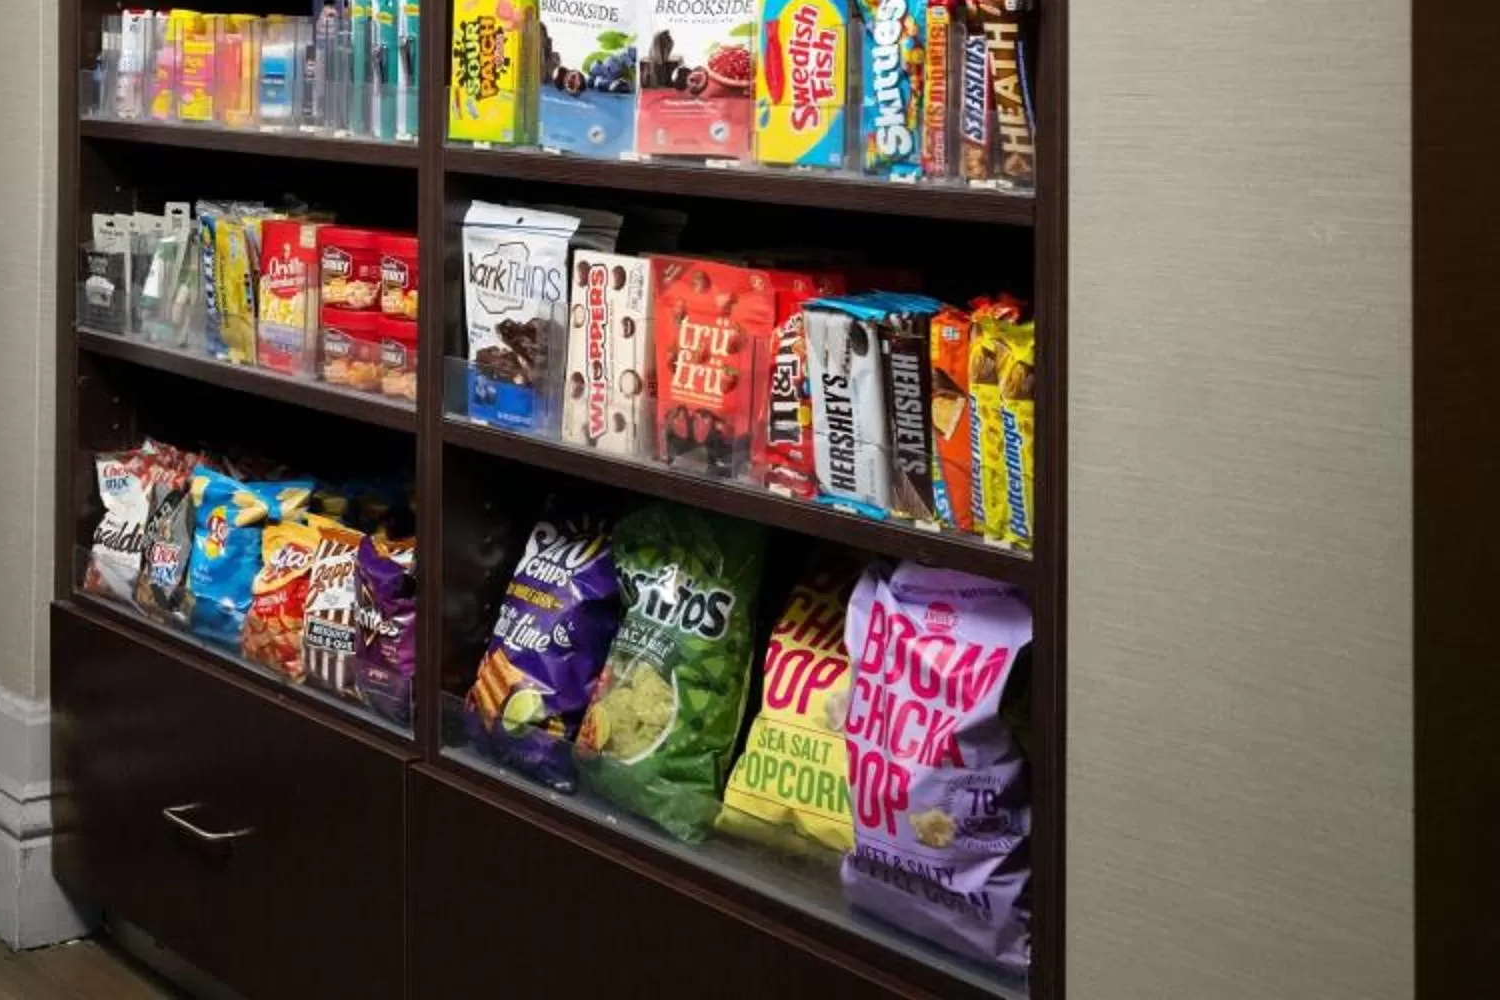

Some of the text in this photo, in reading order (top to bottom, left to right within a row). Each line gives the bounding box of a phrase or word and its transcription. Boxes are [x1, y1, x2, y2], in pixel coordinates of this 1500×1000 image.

[655, 0, 753, 16] BROOKSIDE
[466, 22, 480, 97] SOUR
[791, 4, 819, 131] Swedish
[812, 29, 837, 101] Fish
[984, 22, 1035, 155] HEATH
[822, 373, 857, 492] HERSHEY'S
[1000, 406, 1030, 540] Butterfinger
[526, 556, 573, 587] CHIPS
[860, 600, 1010, 714] BOOM
[758, 727, 832, 765] SEA SALT
